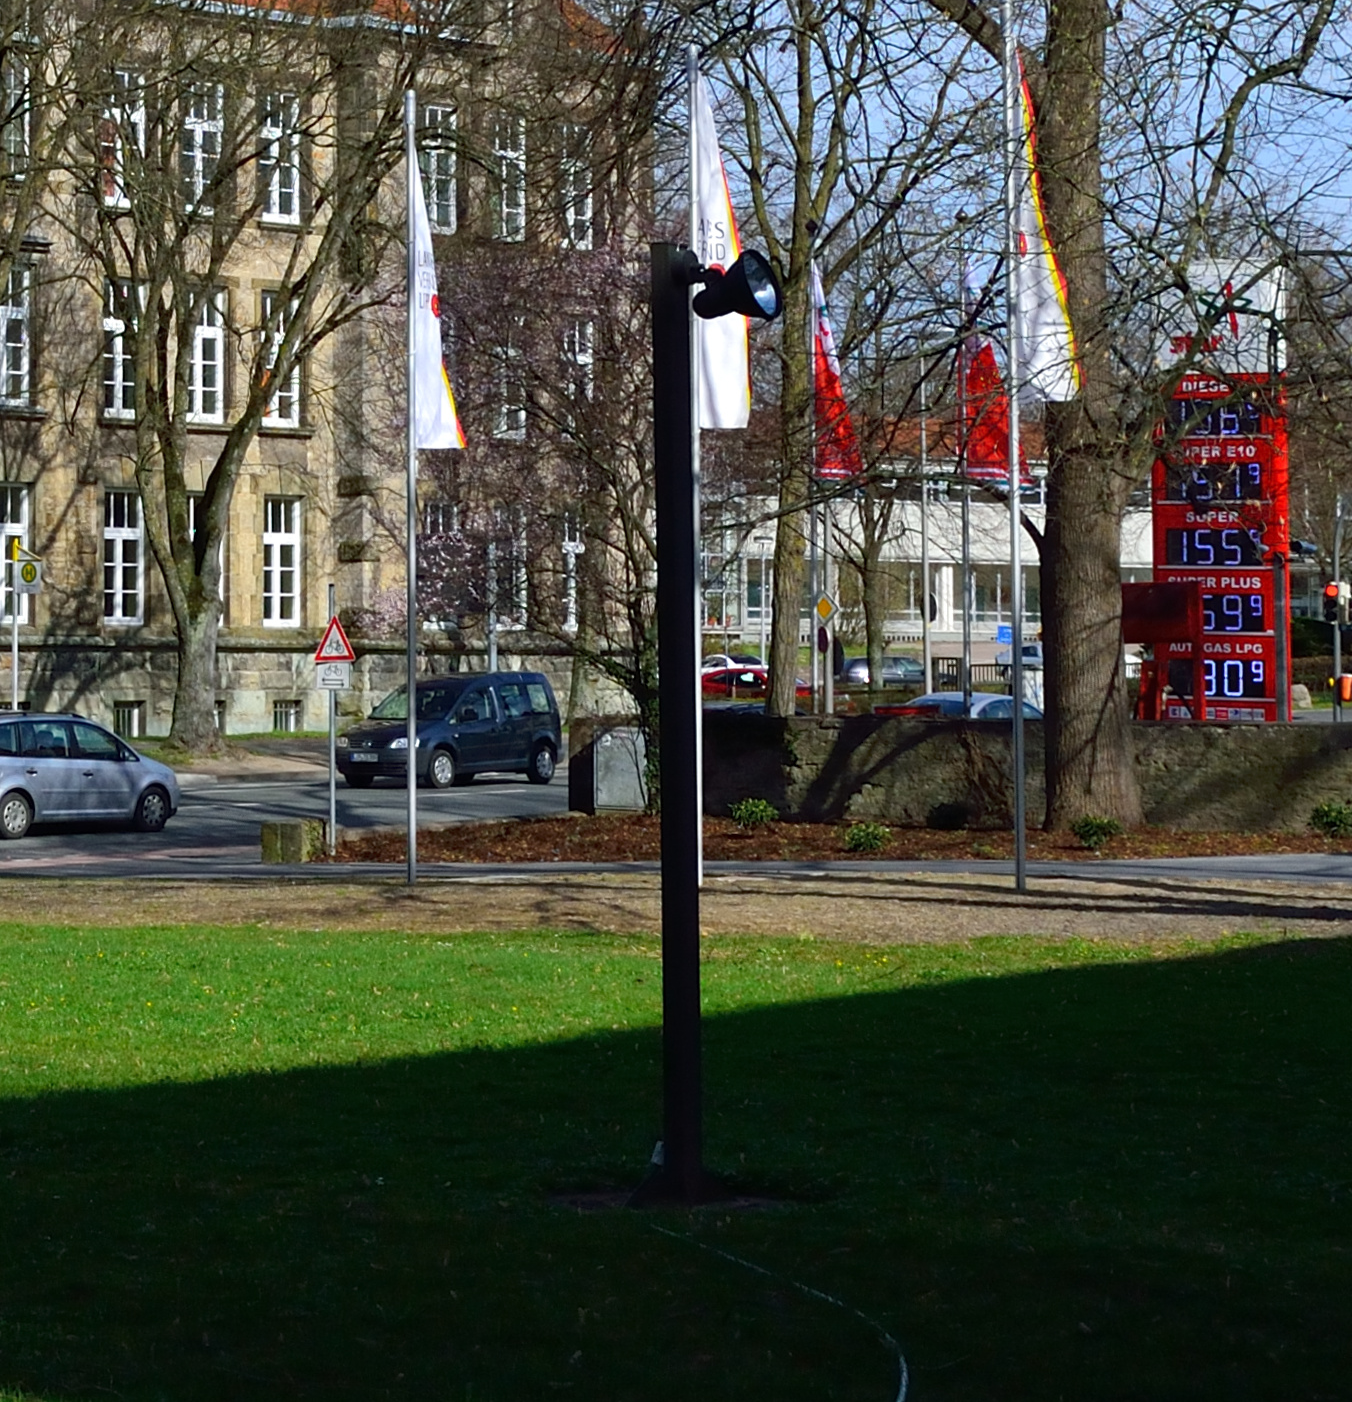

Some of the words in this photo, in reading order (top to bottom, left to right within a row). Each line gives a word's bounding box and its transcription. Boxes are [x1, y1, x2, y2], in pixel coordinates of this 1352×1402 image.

[1182, 380, 1230, 392] DIESE
[1182, 445, 1221, 458] PER
[1227, 445, 1256, 458] E10
[1186, 511, 1239, 523] SUPER
[1221, 576, 1262, 589] PLUS
[1169, 642, 1232, 654] AUTGAS
[1236, 643, 1263, 654] LPG
